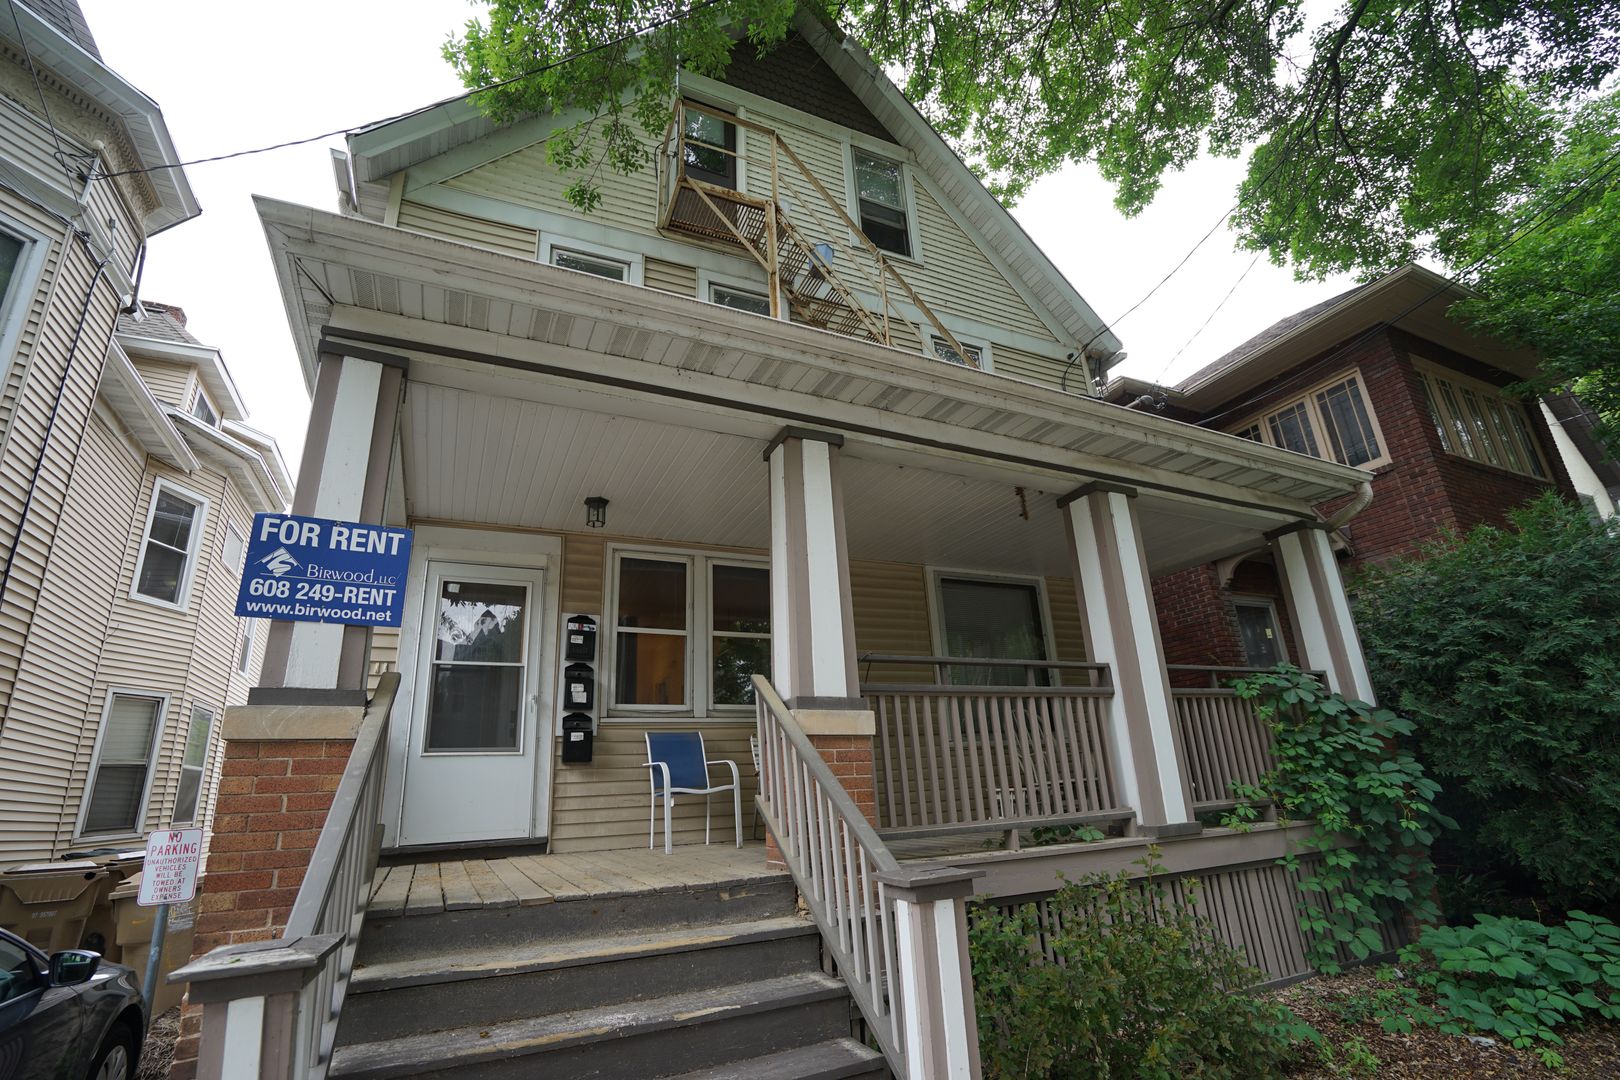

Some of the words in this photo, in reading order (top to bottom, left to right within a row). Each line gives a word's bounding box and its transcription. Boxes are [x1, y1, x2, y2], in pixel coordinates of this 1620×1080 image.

[259, 517, 321, 548] FOR
[329, 526, 405, 556] RENT
[249, 578, 290, 598] 608
[295, 582, 397, 607] 249-RENT
[246, 601, 392, 622] www.birwood.net
[168, 832, 182, 842] NO
[151, 843, 197, 856] PARKING
[147, 856, 197, 866] UNAUTHORIZED
[155, 864, 187, 872] VEHICLES
[154, 885, 181, 893] OWNERS
